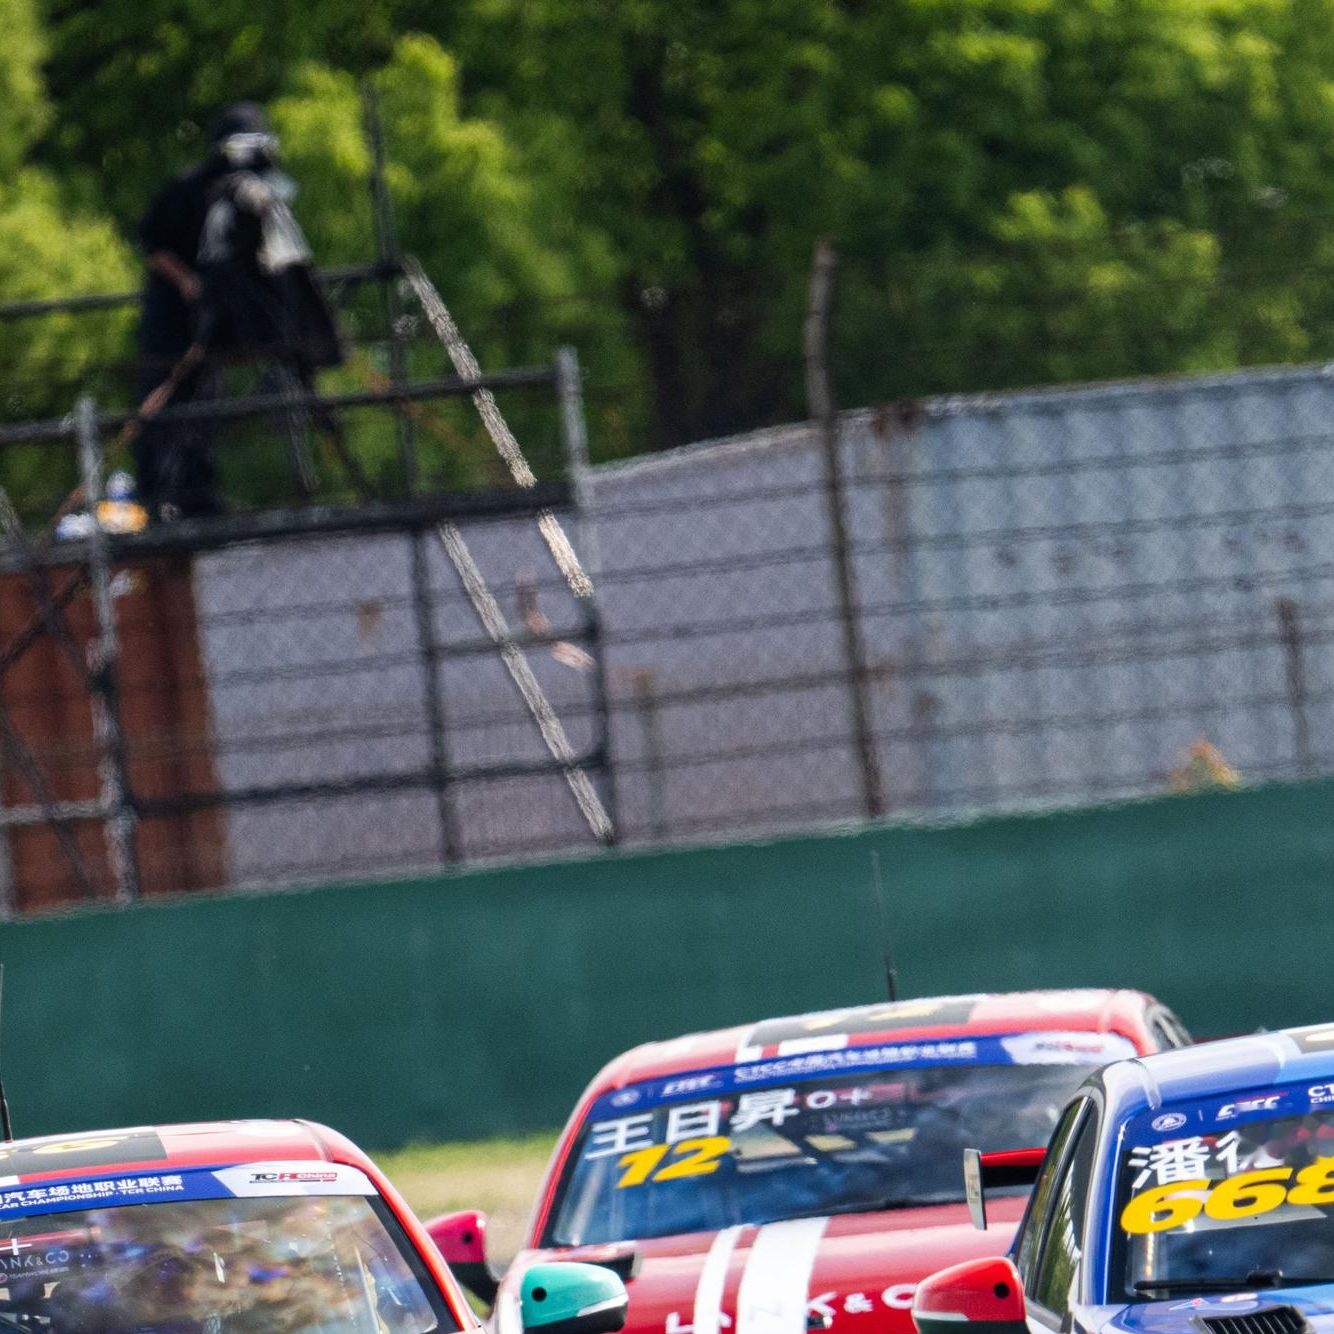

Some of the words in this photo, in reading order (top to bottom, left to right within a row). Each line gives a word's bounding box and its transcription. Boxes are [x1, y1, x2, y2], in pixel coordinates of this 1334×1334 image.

[584, 1087, 800, 1160] 王日昇
[617, 1136, 731, 1189] 12
[20, 1190, 114, 1207] CHAMPIONSHIP
[122, 1188, 144, 1196] TCR
[146, 1184, 185, 1193] CHINA
